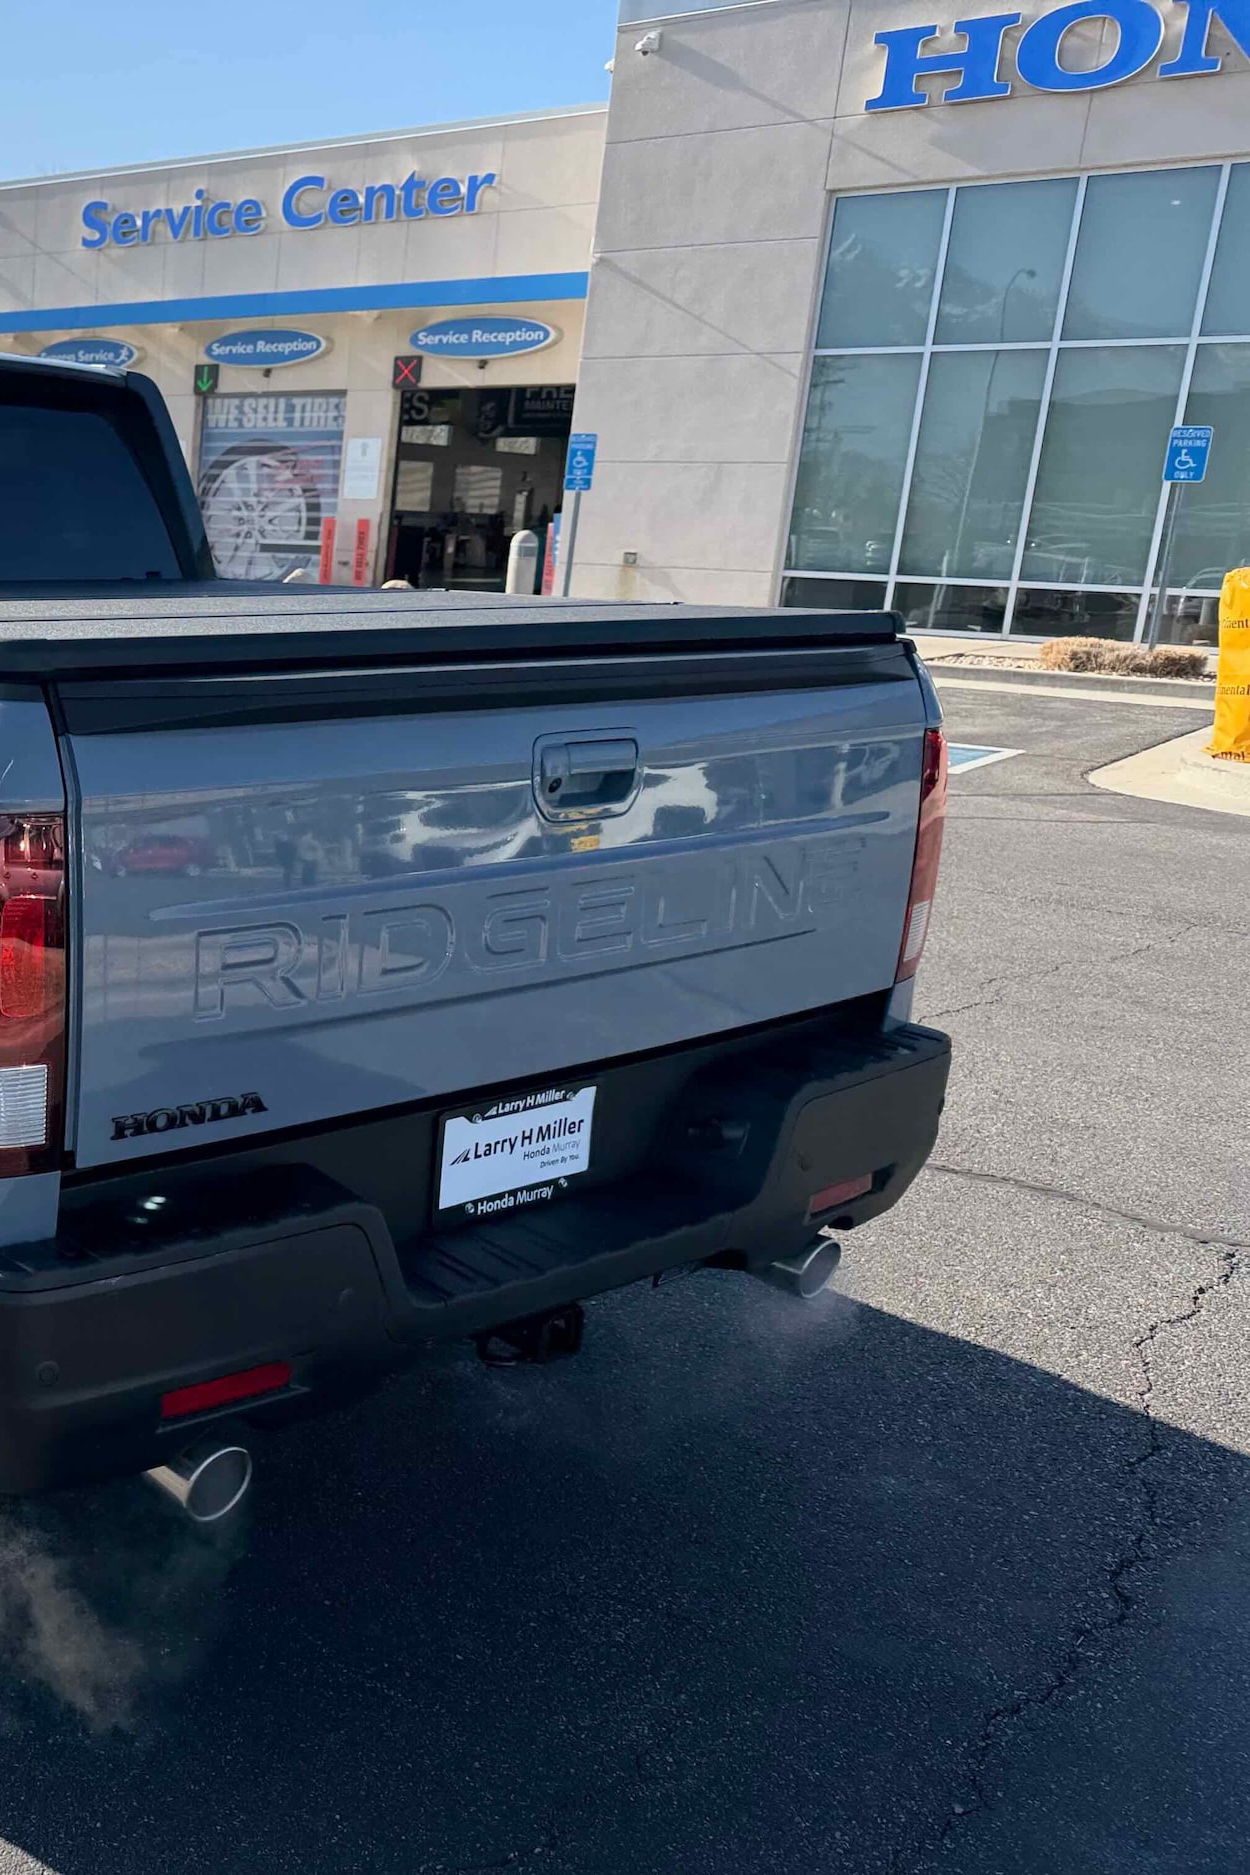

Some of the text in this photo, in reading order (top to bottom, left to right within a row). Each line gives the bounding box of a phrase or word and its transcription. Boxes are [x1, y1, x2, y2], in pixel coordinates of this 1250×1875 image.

[81, 170, 496, 249] Service Center
[211, 339, 317, 355] Service Reception
[417, 328, 544, 345] Service Reception
[78, 345, 115, 362] Service
[207, 397, 239, 428] WE
[242, 397, 288, 428] SELL
[1172, 439, 1207, 447] PARKING
[1173, 471, 1195, 479] ONLY
[498, 1089, 565, 1114] Larry H Miller
[110, 1092, 268, 1140] HONDA
[473, 1117, 585, 1160] Larry H Miller
[523, 1139, 581, 1161] Honda Murray
[539, 1158, 559, 1169] Driven
[561, 1156, 568, 1165] By
[477, 1185, 554, 1215] Honda Murray
